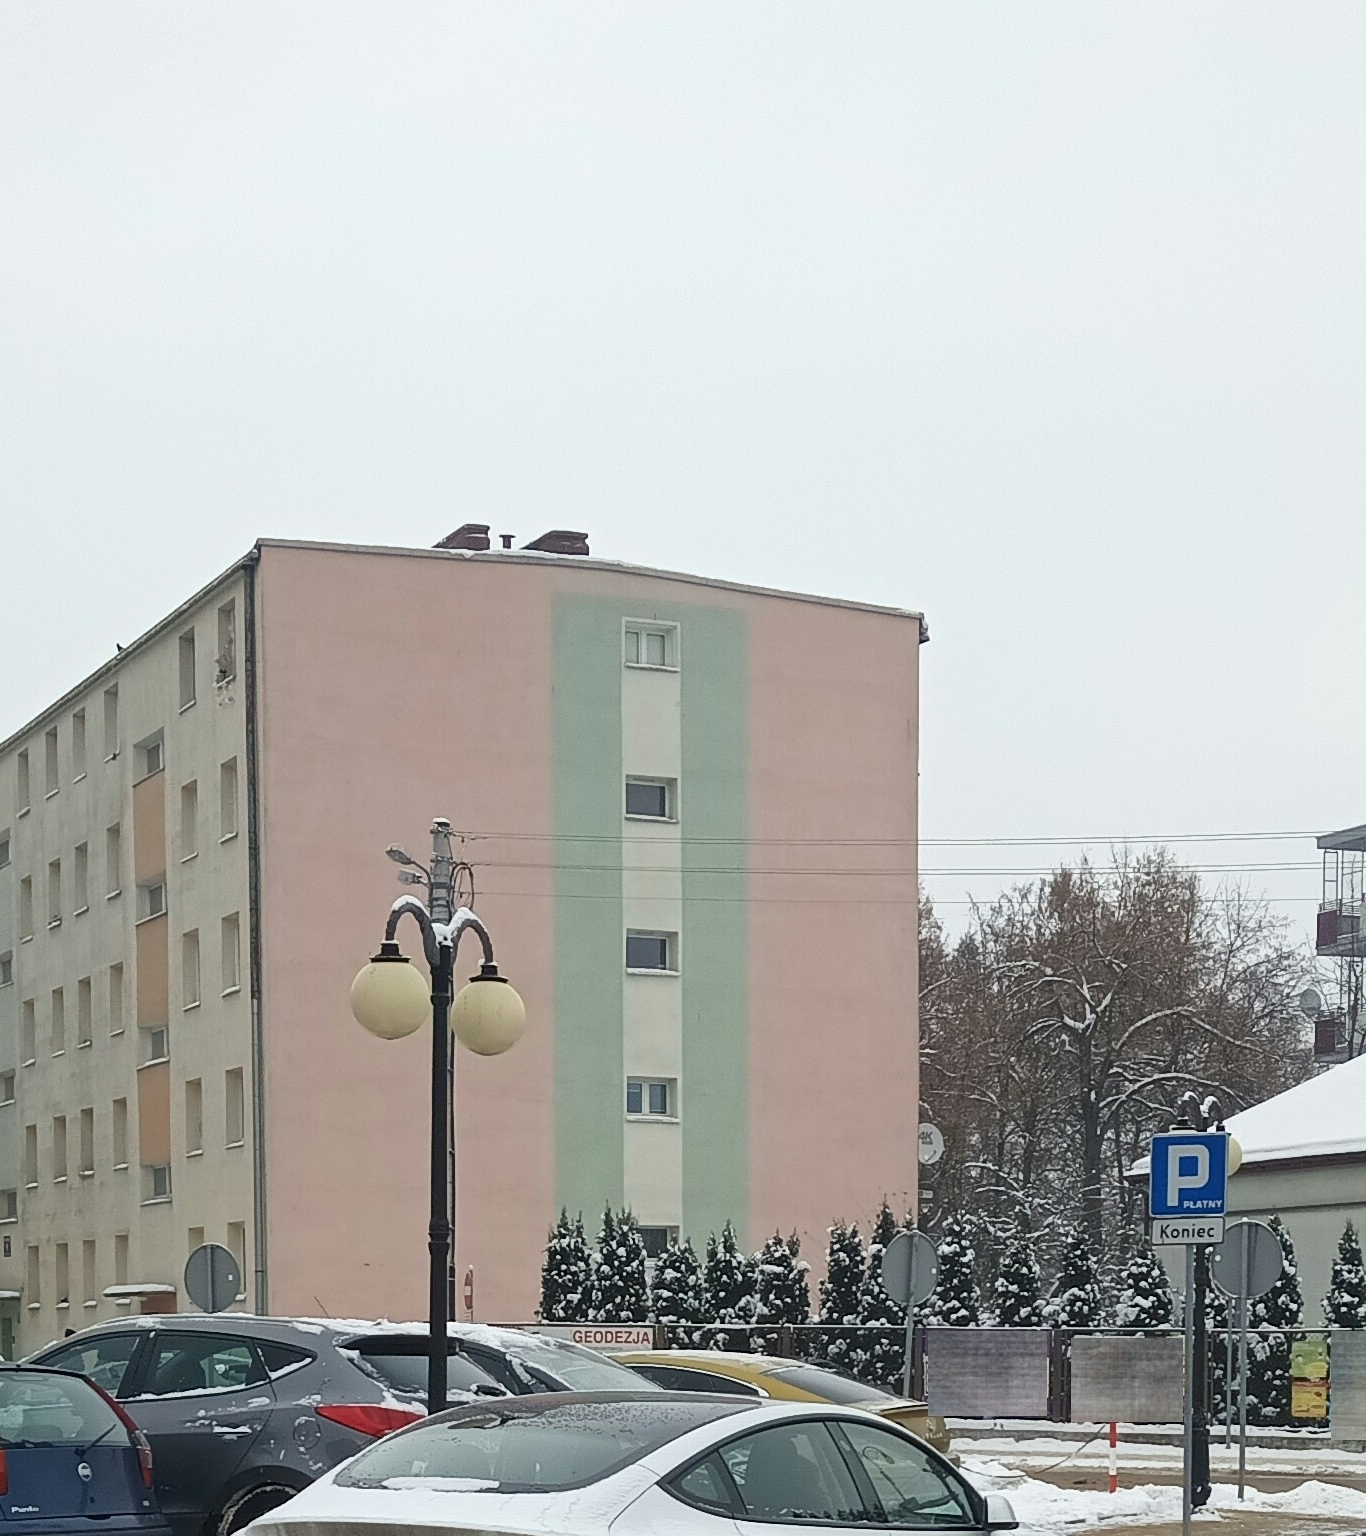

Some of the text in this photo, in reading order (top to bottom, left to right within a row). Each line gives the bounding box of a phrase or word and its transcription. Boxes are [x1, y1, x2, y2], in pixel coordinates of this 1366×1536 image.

[1167, 1144, 1210, 1207] P
[1183, 1200, 1223, 1209] PŁATNY
[1160, 1223, 1215, 1239] Koniec
[572, 1330, 651, 1345] GEODEZJA
